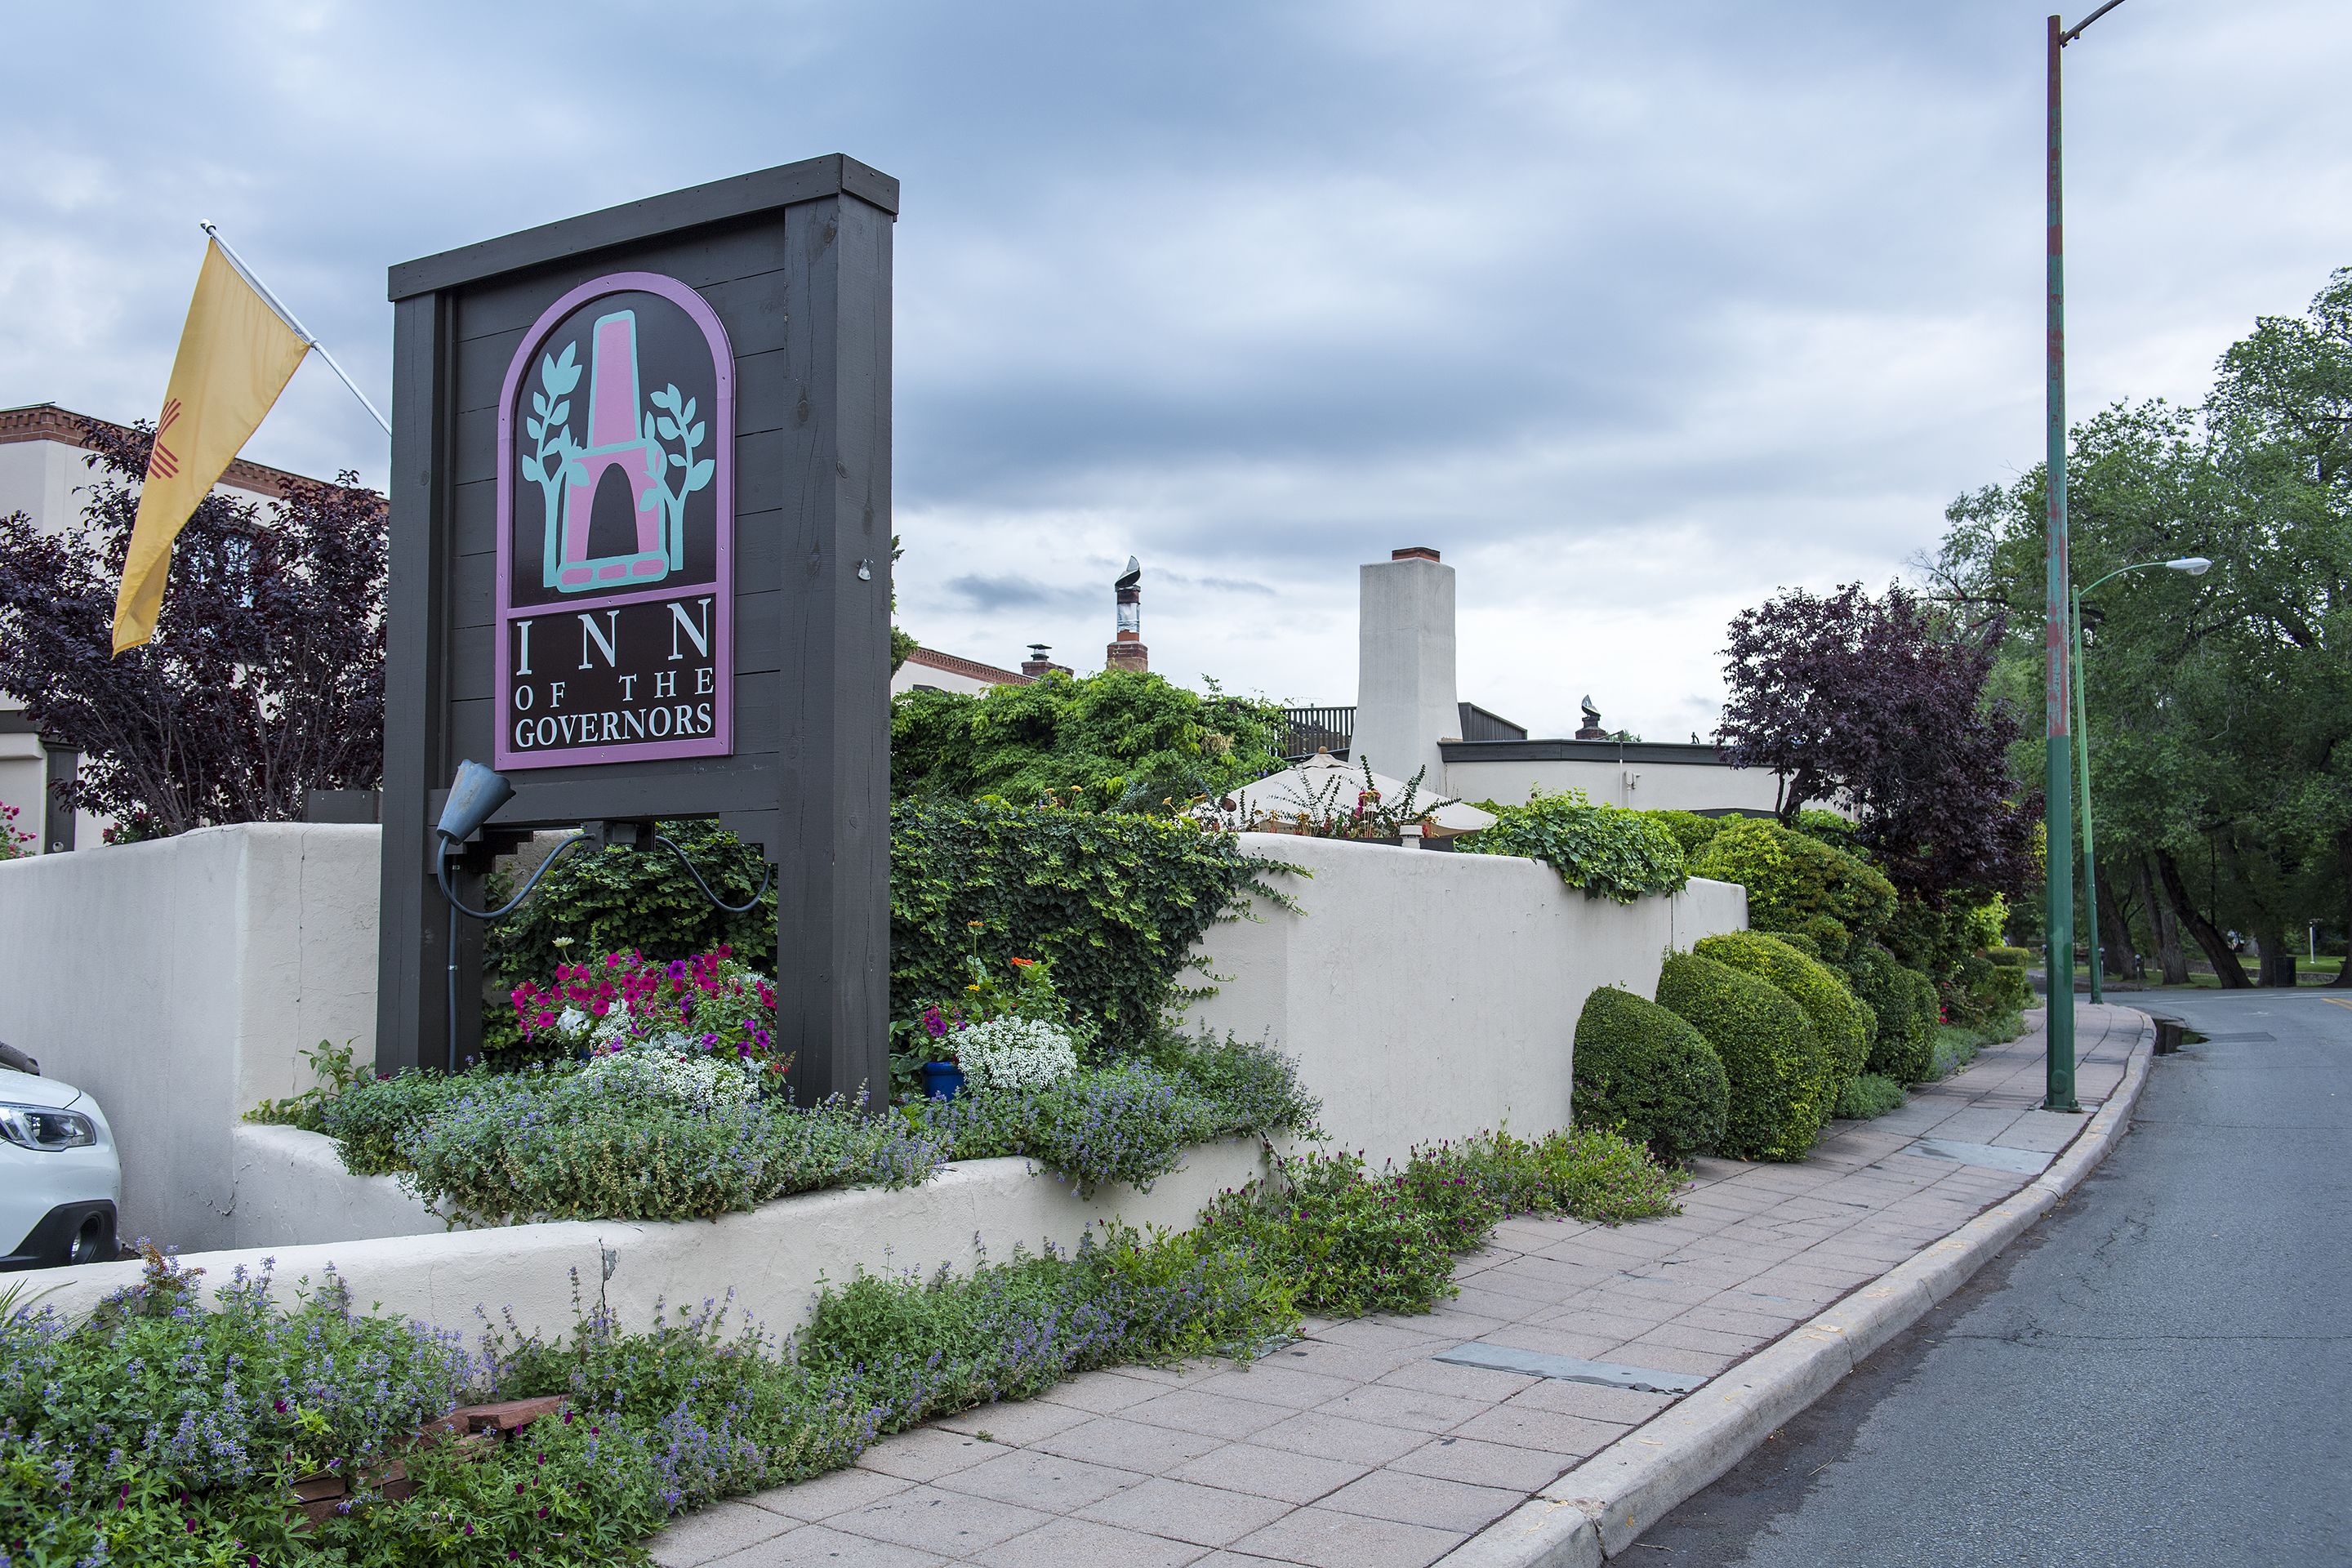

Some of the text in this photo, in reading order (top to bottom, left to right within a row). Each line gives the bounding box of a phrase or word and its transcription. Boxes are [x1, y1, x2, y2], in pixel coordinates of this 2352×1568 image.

[516, 598, 712, 676] INN
[514, 666, 715, 711] OF THE
[514, 702, 713, 748] GOVERNORS
